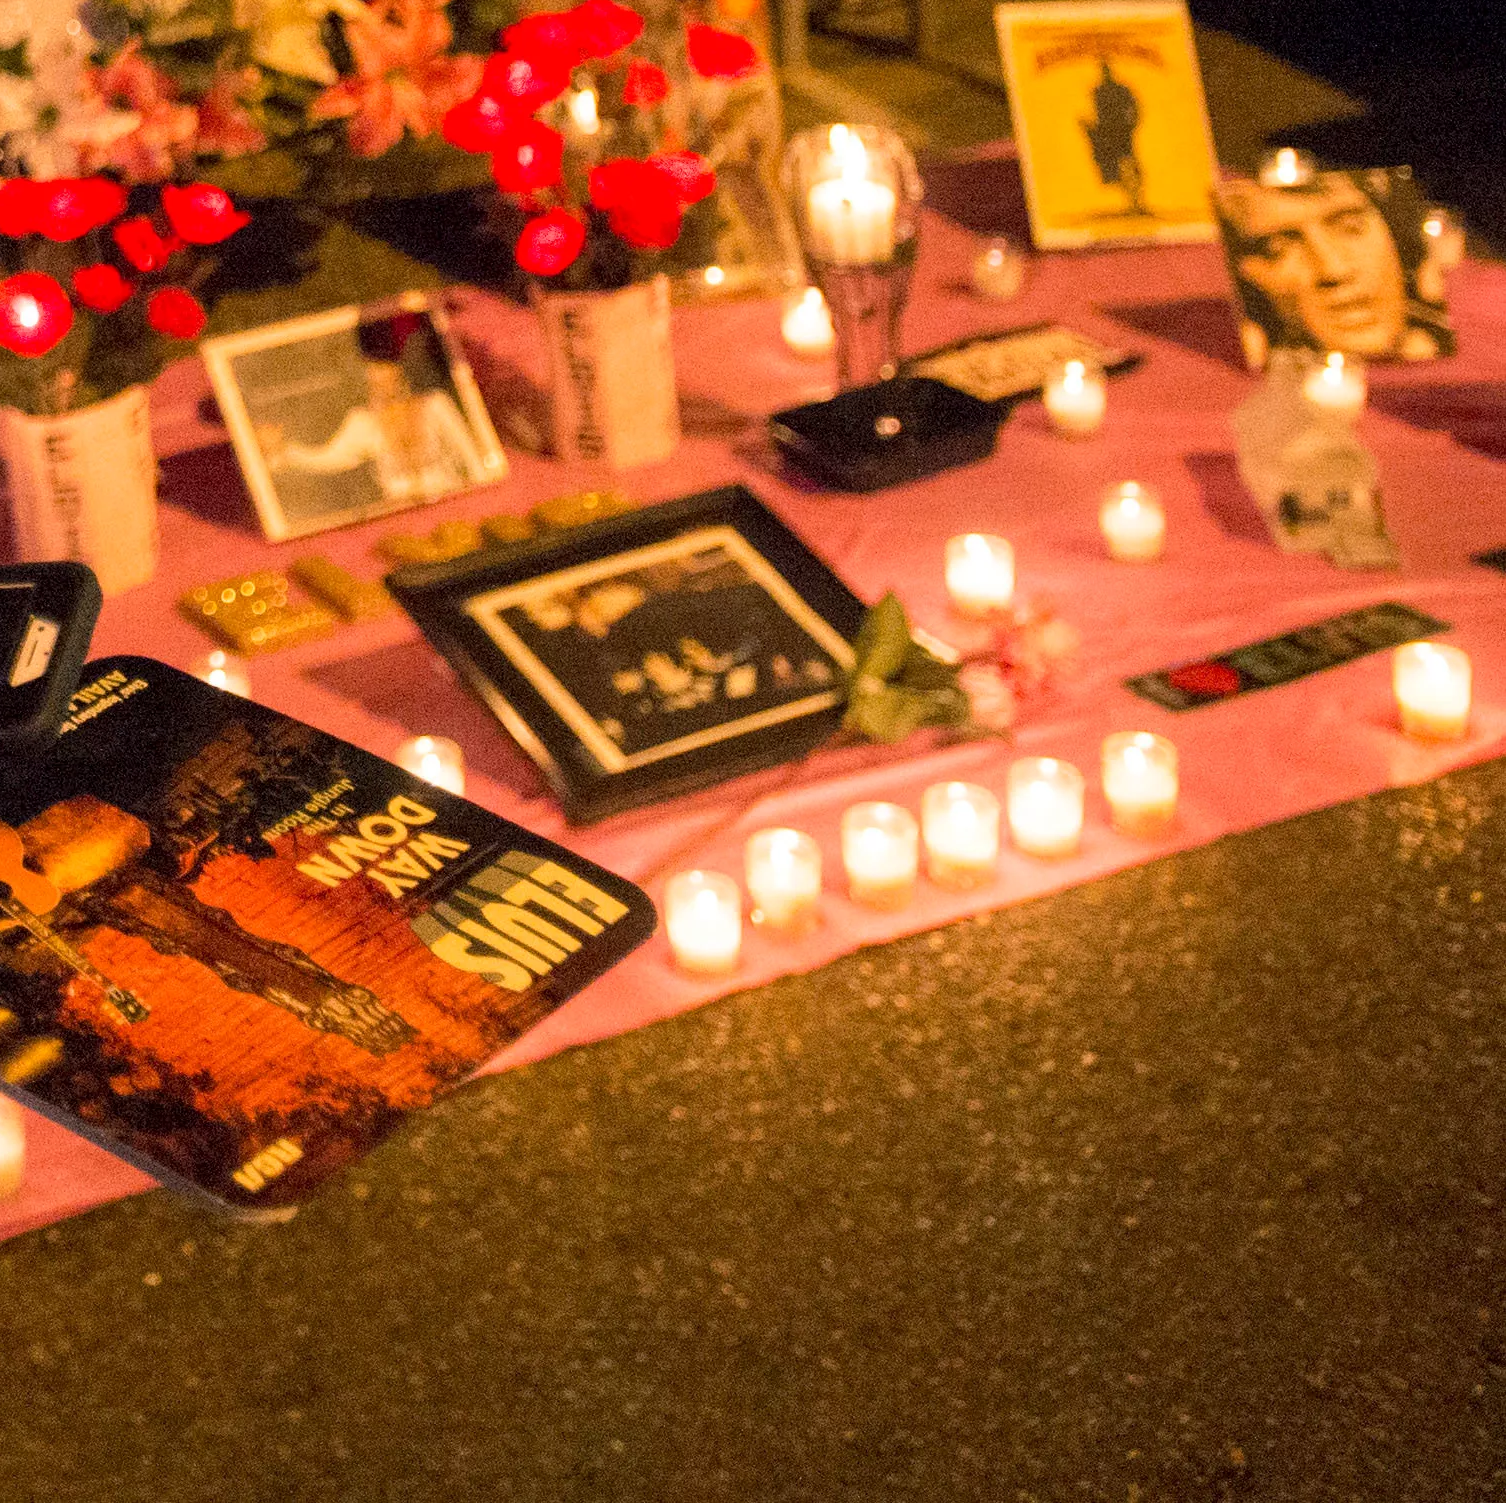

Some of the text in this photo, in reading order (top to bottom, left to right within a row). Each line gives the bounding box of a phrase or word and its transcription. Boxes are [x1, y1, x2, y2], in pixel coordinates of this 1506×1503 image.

[261, 777, 355, 842] Jungle Room
[296, 795, 438, 888] DOWN
[366, 831, 471, 900] WAY
[412, 851, 629, 993] ELVIS
